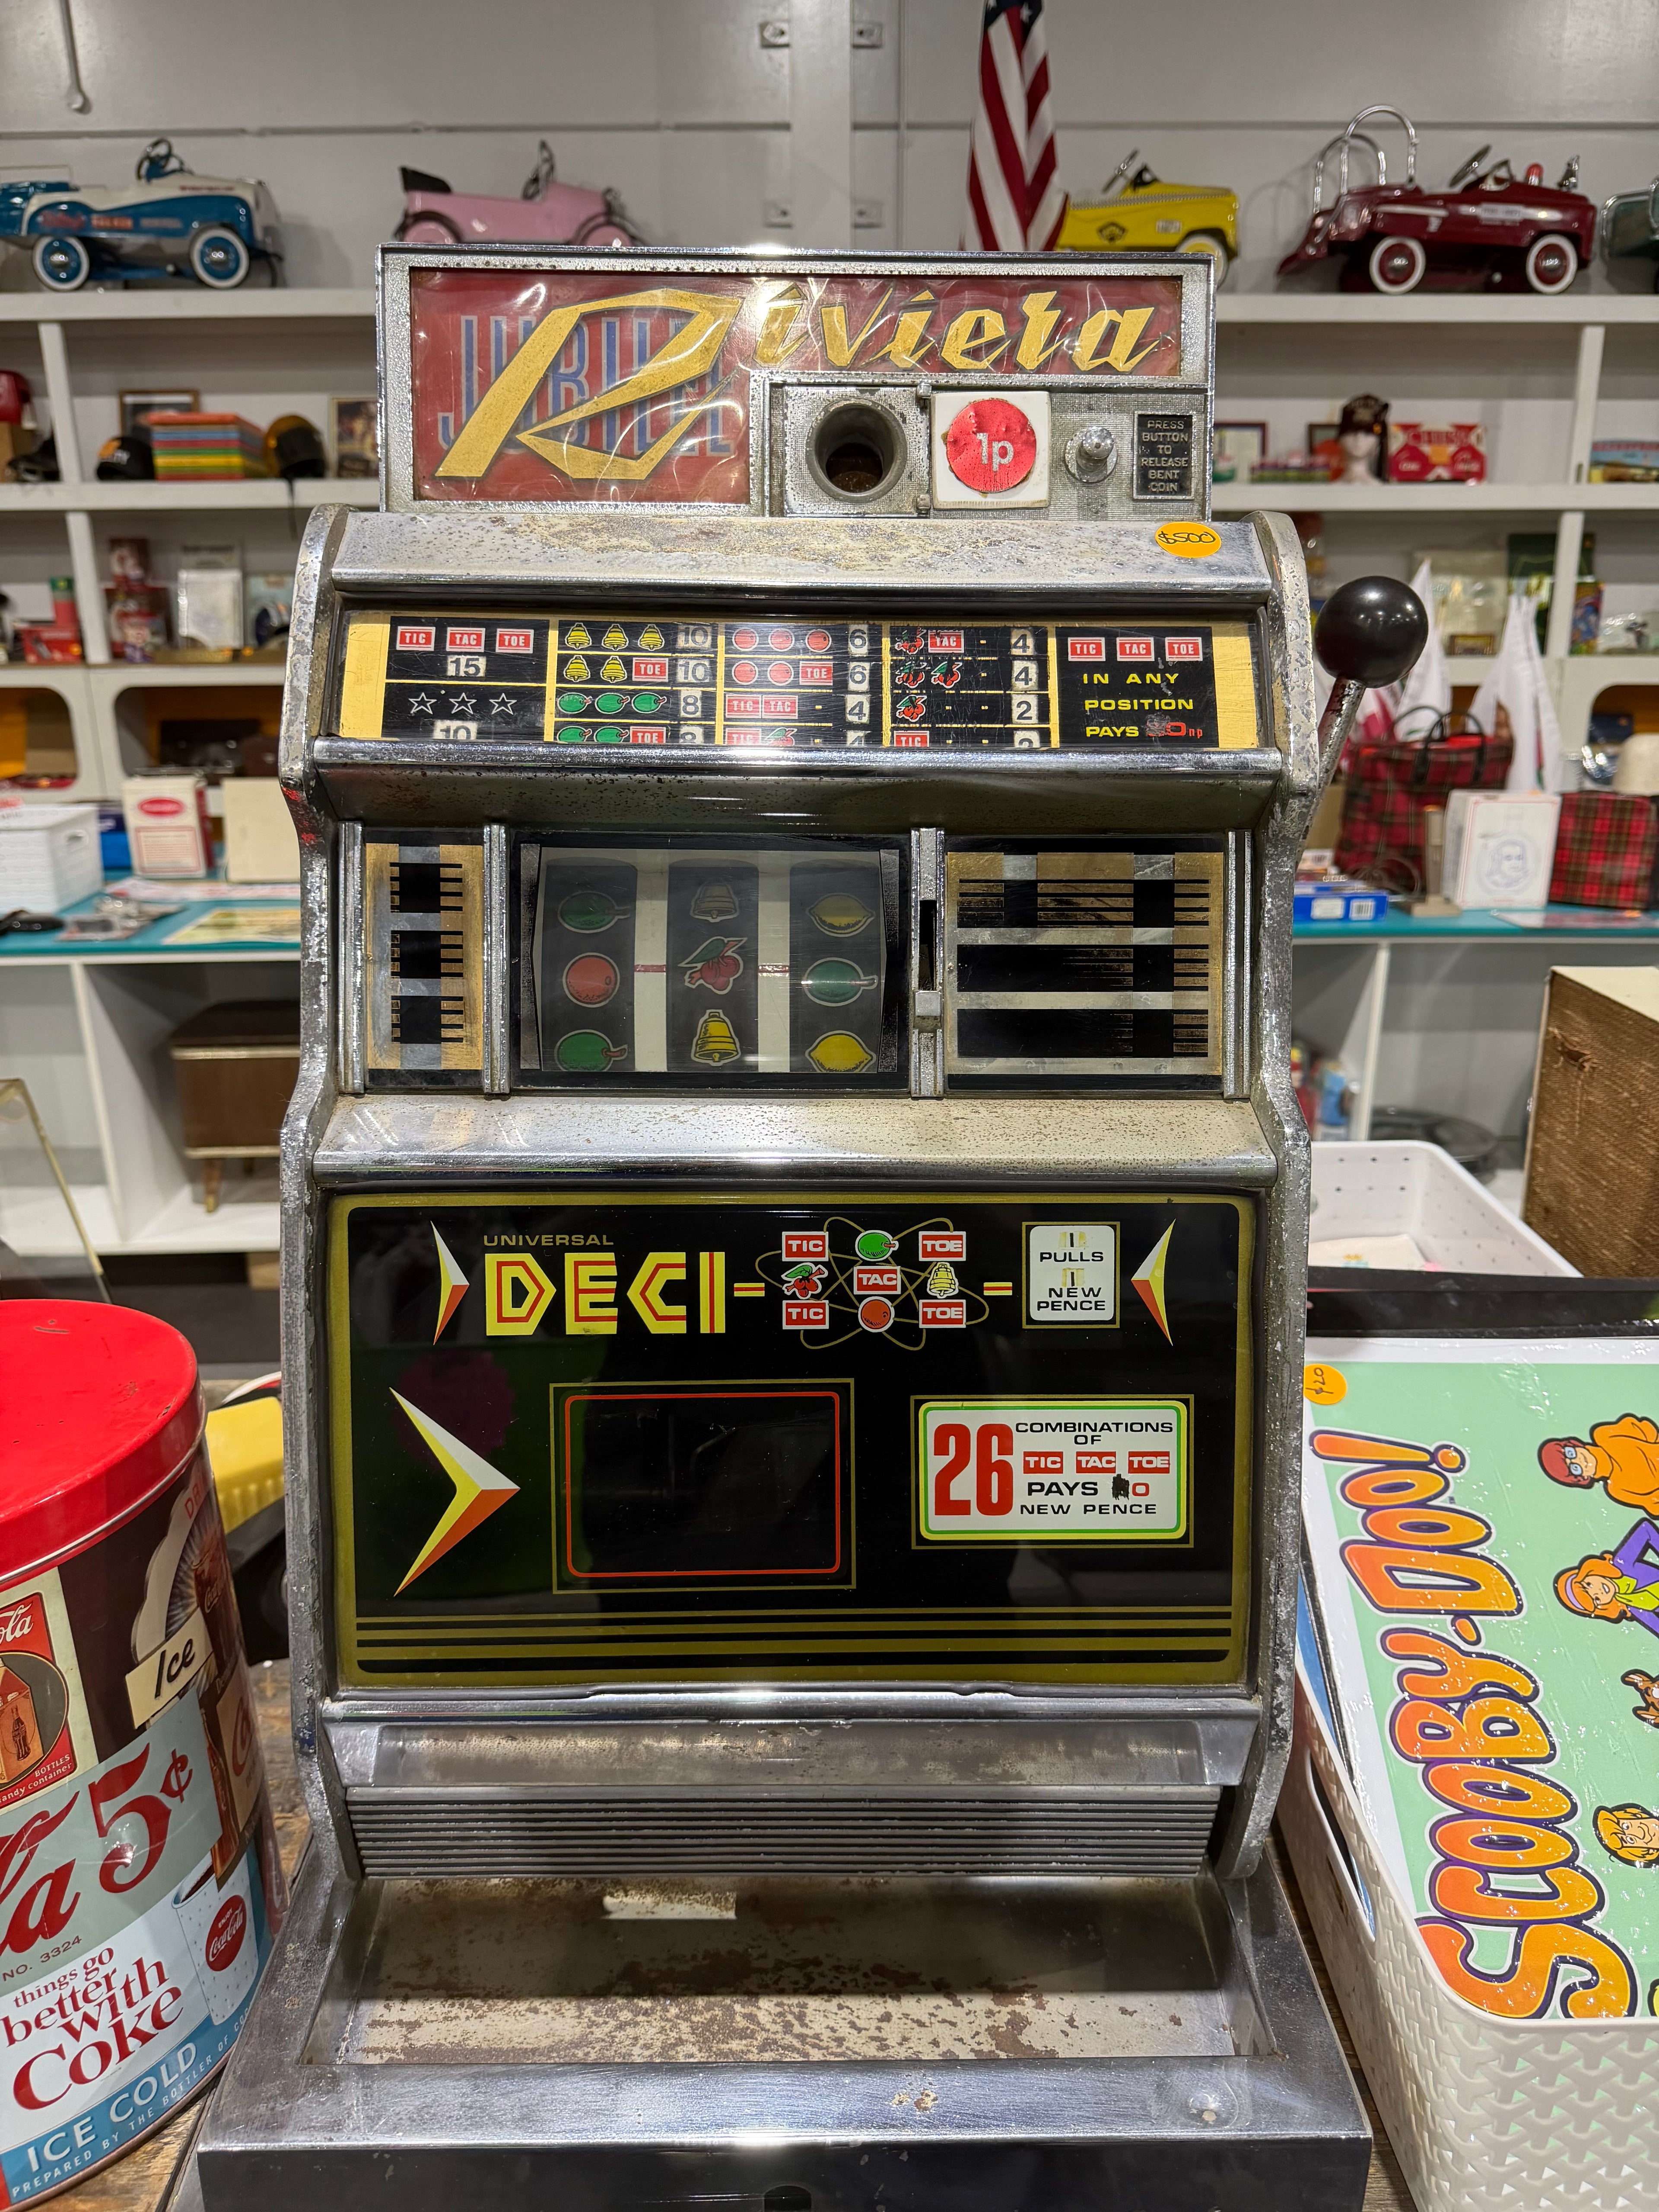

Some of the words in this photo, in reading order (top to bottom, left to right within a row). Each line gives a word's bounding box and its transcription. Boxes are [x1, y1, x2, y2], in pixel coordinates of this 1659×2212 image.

[1147, 420, 1184, 429] PRESS
[1142, 432, 1188, 442] BUTTON
[977, 432, 1014, 471] 1p
[1157, 445, 1172, 454] TO
[1141, 458, 1188, 467] RELEASE
[1148, 470, 1180, 479] BENT
[1150, 482, 1178, 492] COIN
[1158, 531, 1216, 544] $500
[405, 633, 426, 644] TIC
[454, 634, 477, 645] TAC
[504, 635, 524, 647] TOE
[680, 627, 708, 646] 10
[849, 629, 867, 647] 6
[936, 636, 957, 647] TAC
[1013, 634, 1030, 653] 4
[1075, 644, 1096, 655] TIC
[1125, 644, 1146, 655] TAC
[1173, 644, 1194, 655] TOE
[450, 658, 481, 677] 15
[640, 664, 661, 676] TOE
[679, 662, 709, 682] 10
[806, 667, 827, 680] TOE
[849, 666, 867, 685] 6
[1015, 667, 1032, 686] 4
[1083, 674, 1109, 684] IN
[1126, 673, 1179, 684] ANY
[682, 695, 699, 715] 8
[733, 701, 753, 711] TIC
[769, 701, 791, 712] TAC
[849, 701, 866, 721] 4
[1016, 701, 1033, 720] 2
[1084, 699, 1193, 711] POSITION
[637, 732, 658, 743] TOE
[1086, 726, 1139, 737] PAYS
[733, 734, 753, 744] TIC
[901, 737, 921, 747] TIC
[484, 1235, 614, 1246] UNIVERSAL
[788, 1240, 824, 1253] TIC
[922, 1239, 963, 1253] TOE
[1040, 1252, 1104, 1262] PULLS
[858, 1273, 897, 1287] TAC
[1049, 1287, 1102, 1298] NEW
[1037, 1300, 1105, 1311] PENCE
[788, 1307, 824, 1321] TIC
[923, 1307, 963, 1321] TOE
[1016, 1422, 1173, 1433] COMBINATIONS
[1074, 1435, 1101, 1445] OF
[1025, 1456, 1061, 1468] TIC
[1077, 1456, 1116, 1468] TAC
[1128, 1456, 1169, 1468] TOE
[934, 1423, 1014, 1516] 26
[1027, 1481, 1098, 1496] PAYS
[1020, 1504, 1071, 1515] NEW
[1084, 1504, 1156, 1515] PENCE
[155, 1638, 194, 1699] Ice
[35, 1754, 70, 1777] BOTTLES
[28, 1763, 72, 1789] container
[219, 1907, 232, 1929] ENJOY
[3, 1964, 32, 1981] NO.
[40, 1935, 83, 1963] 3324
[13, 1970, 78, 2009] things
[83, 1947, 114, 1982] go
[57, 1957, 169, 2043] with
[1, 1967, 119, 2048] better
[13, 1986, 184, 2110] Coke
[27, 2116, 97, 2173] ICE
[110, 2043, 197, 2123] COLD
[12, 2150, 92, 2197] PREPARED
[102, 2132, 119, 2150] BY
[129, 2107, 154, 2130] THE
[163, 2055, 212, 2106] BOTTLER
[218, 2035, 228, 2052] OF
